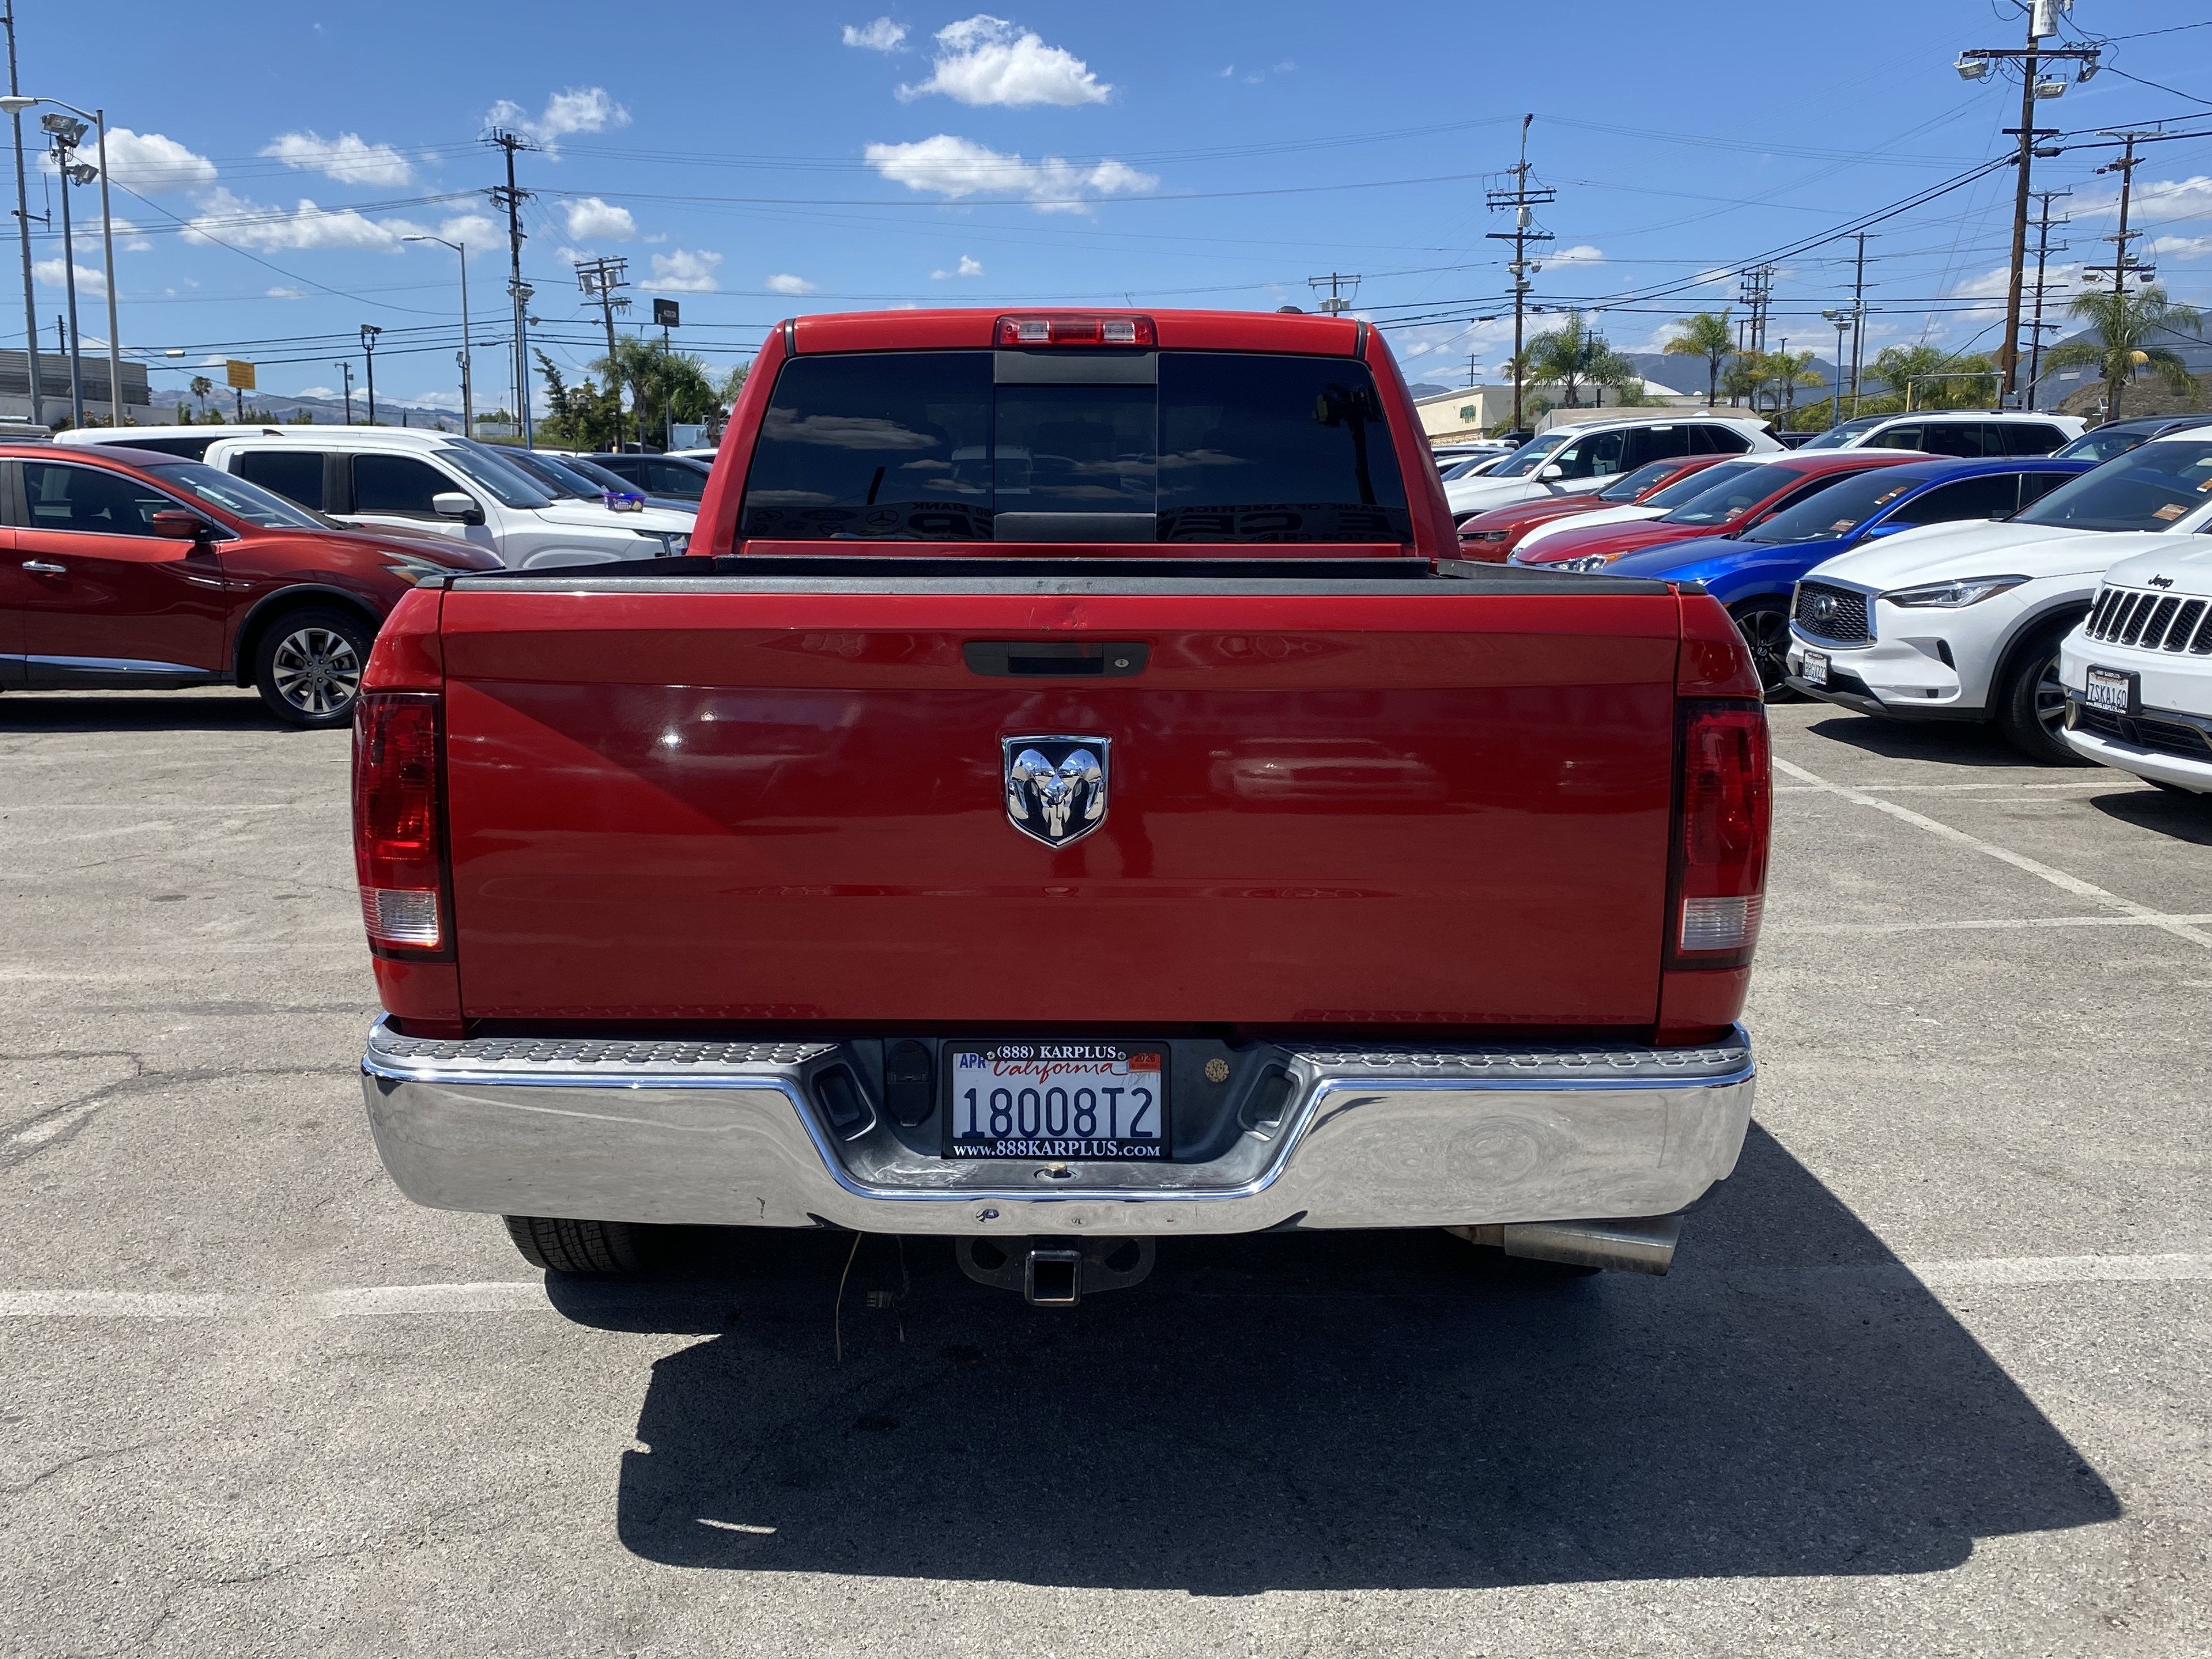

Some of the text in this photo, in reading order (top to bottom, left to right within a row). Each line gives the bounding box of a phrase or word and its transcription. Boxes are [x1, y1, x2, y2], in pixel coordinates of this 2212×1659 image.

[2148, 574, 2174, 590] Jeep
[2089, 682, 2126, 709] 7SKA160
[997, 1046, 1116, 1059] (888) KARPLUS
[1135, 1053, 1156, 1062] 2026
[960, 1053, 987, 1069] APR
[993, 1060, 1128, 1085] California
[961, 1087, 1153, 1138] 18008T2
